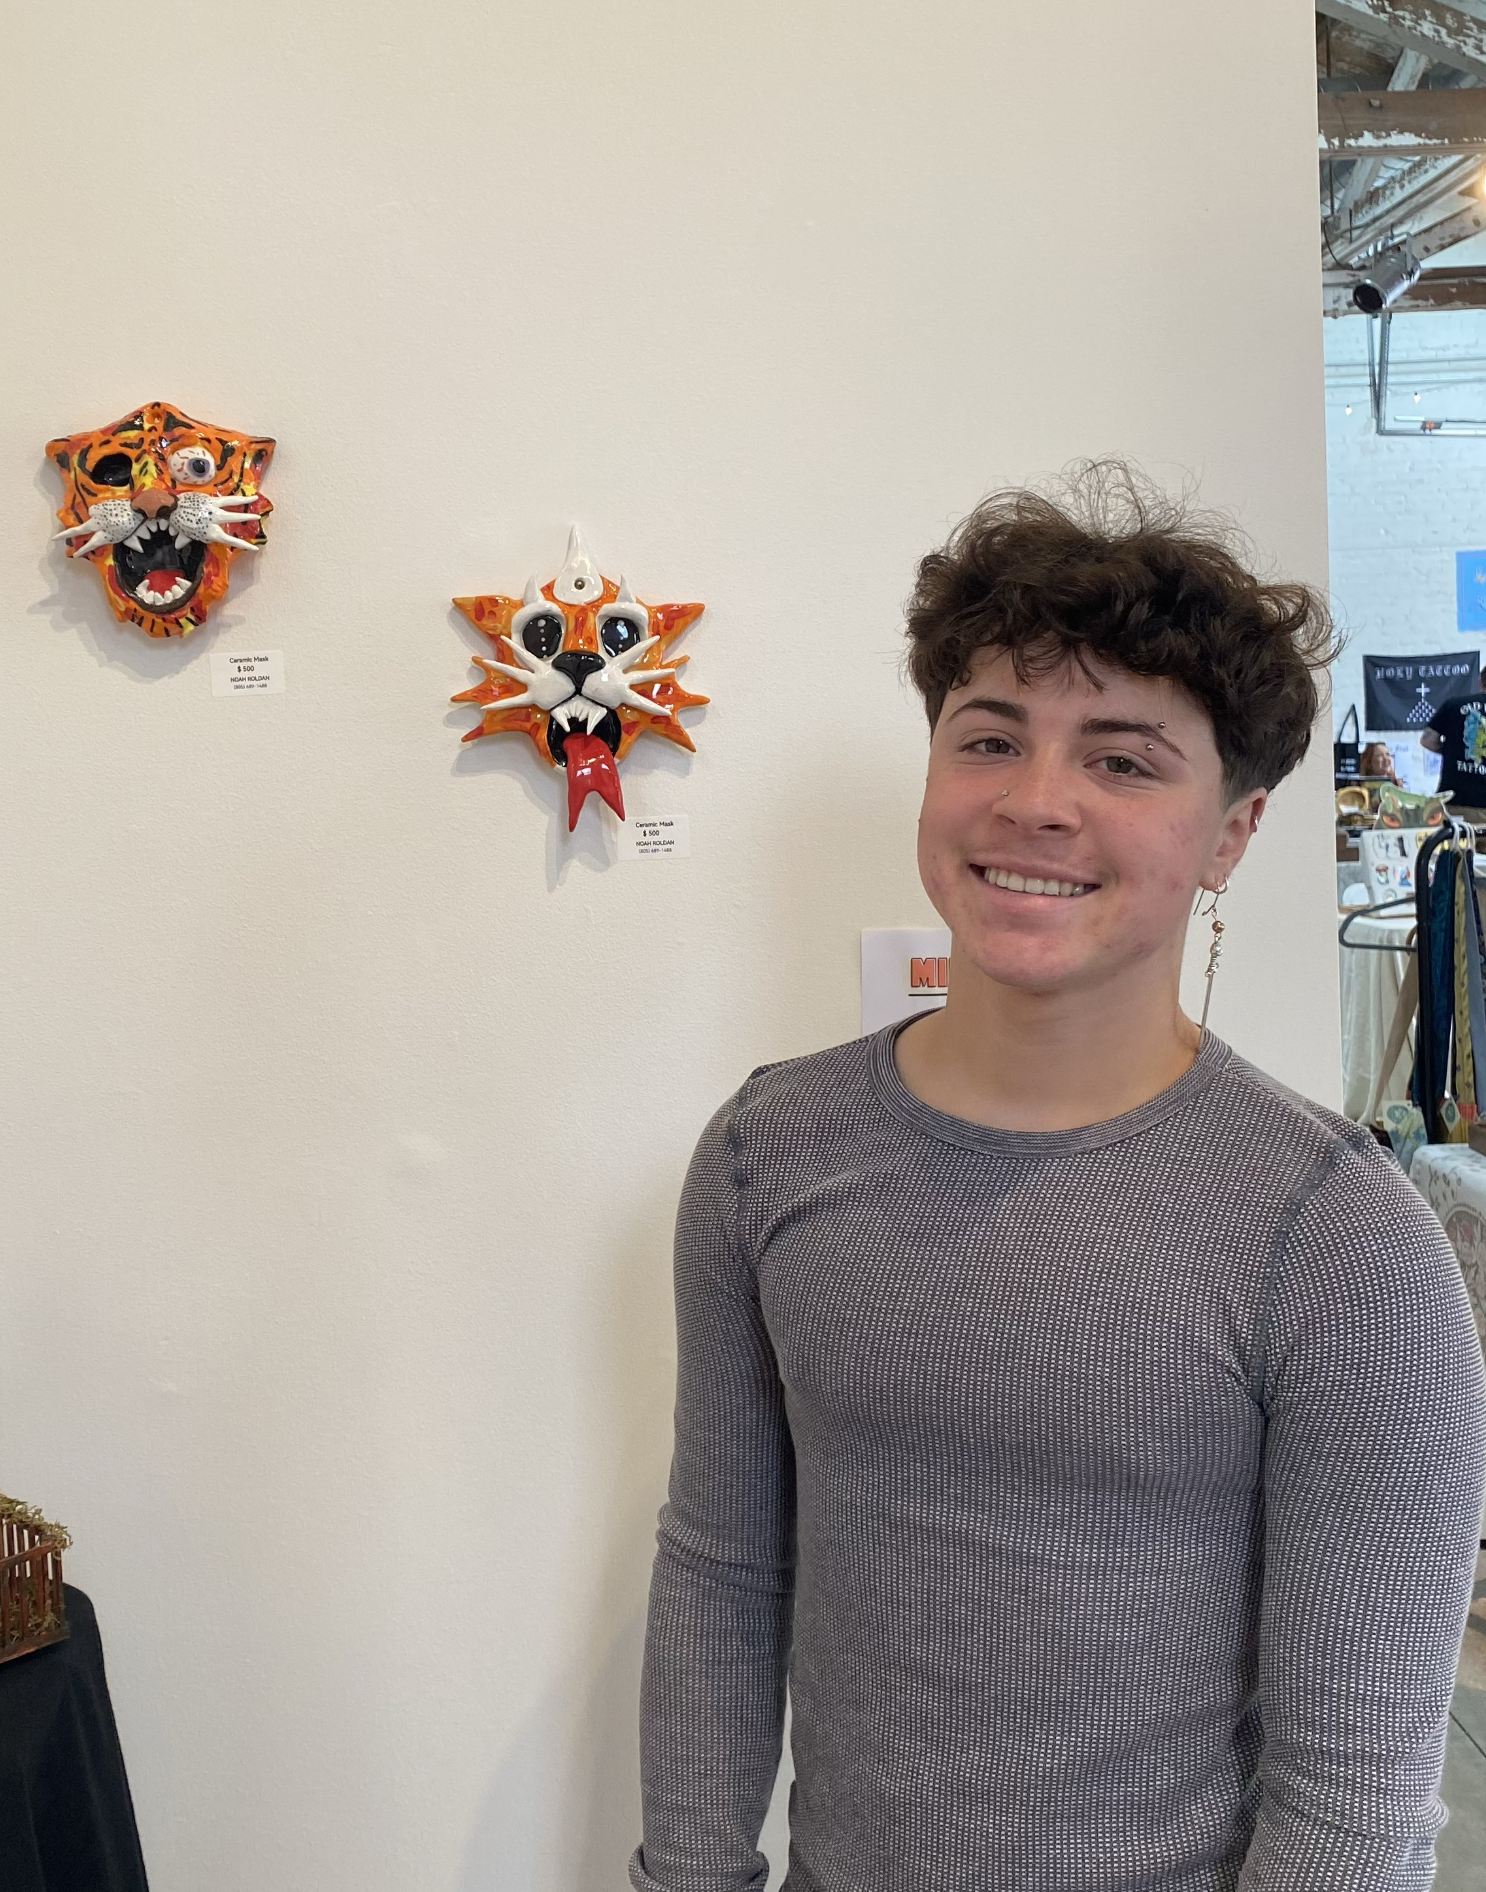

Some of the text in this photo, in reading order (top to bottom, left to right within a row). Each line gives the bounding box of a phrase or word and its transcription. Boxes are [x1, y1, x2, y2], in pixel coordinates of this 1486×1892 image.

[229, 656, 252, 664] Ceramic
[237, 665, 242, 673] $
[1375, 663, 1470, 681] HOLY TATTOO
[1457, 760, 1486, 775] TATTO
[910, 957, 951, 988] MI
